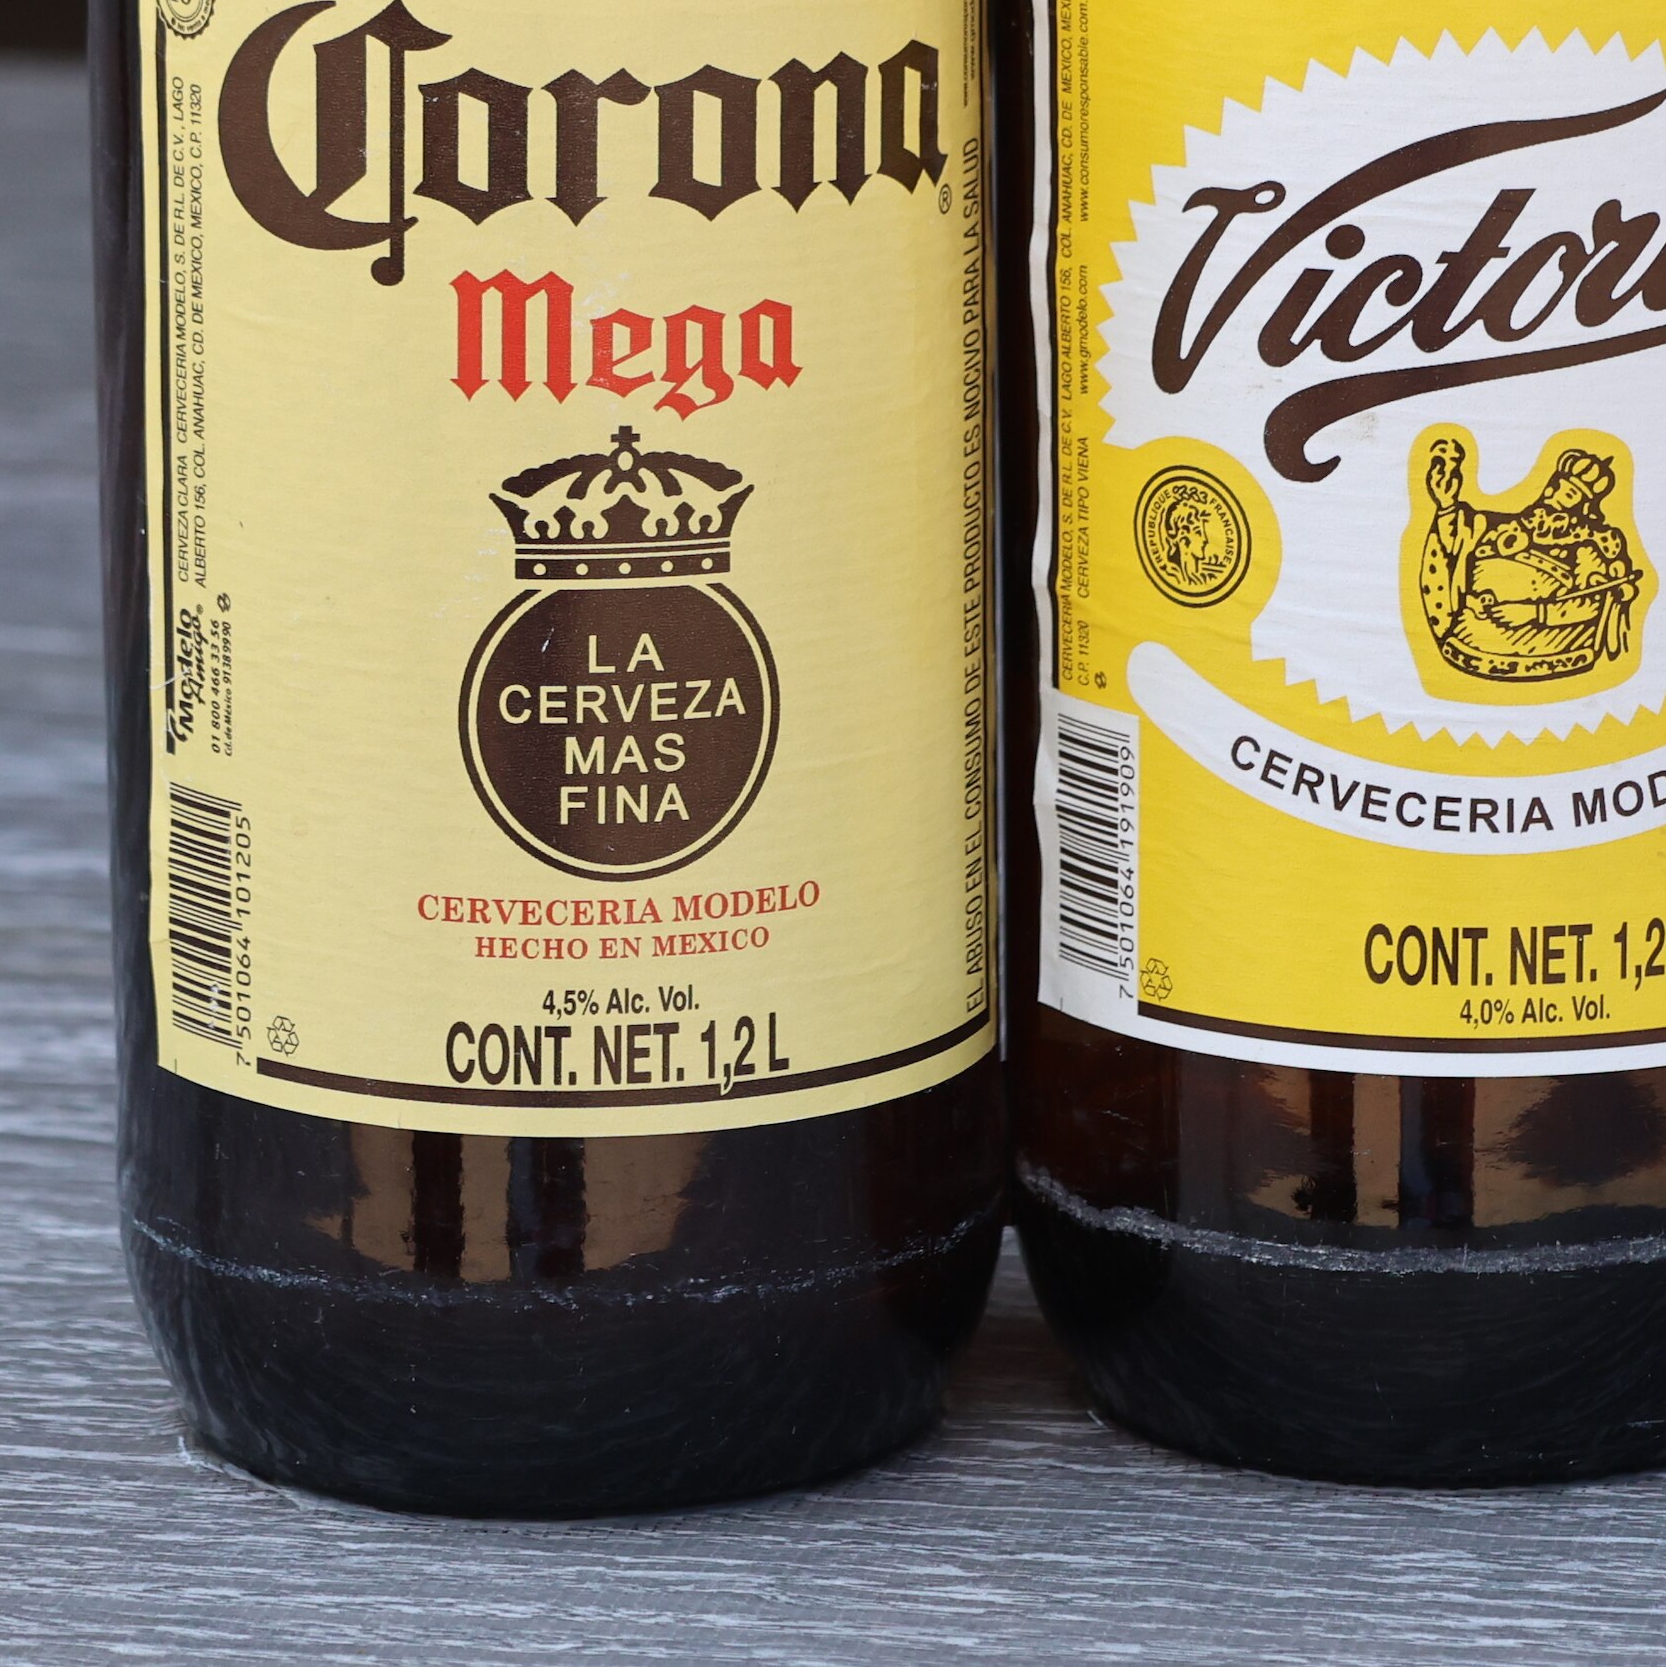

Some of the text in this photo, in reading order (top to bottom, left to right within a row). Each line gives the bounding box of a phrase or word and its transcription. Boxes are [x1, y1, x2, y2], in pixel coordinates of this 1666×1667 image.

[1060, 36, 1073, 94] MEXICO,
[172, 77, 184, 121] LAGO
[1061, 100, 1072, 121] DE
[1061, 125, 1072, 149] CD.
[174, 165, 185, 187] DE
[1061, 154, 1073, 224] ANAHUAC,
[174, 193, 185, 219] R.L.
[174, 224, 185, 245] DE
[174, 251, 185, 265] S.
[1060, 267, 1072, 292] 156,
[175, 269, 187, 341] MODELO,
[1060, 295, 1072, 360] ALBERTO
[189, 84, 206, 588] ALBERTO 156, COL. ANAHUAC, CD. DE MEXICO, MEXICO, C.P. 11320
[450, 268, 803, 421] Mega
[1076, 265, 1091, 395] www.gmodelo.com
[176, 343, 187, 443] CERVECERIA
[1060, 361, 1072, 401] LAGO
[1061, 408, 1073, 434] C.V.
[1061, 437, 1073, 457] DE
[1077, 437, 1090, 483] VIENA
[177, 455, 188, 507] CLARA
[1061, 461, 1073, 485] R.L.
[1061, 489, 1073, 508] DE
[1061, 513, 1073, 524] S.
[1077, 484, 1090, 523] TIPO
[178, 510, 189, 583] CERVEZA
[1061, 529, 1073, 591] MODELO,
[1077, 526, 1090, 599] CERVEZA
[963, 138, 983, 1013] EL ABUSO EN EL CONSUMO DE ESTE PRODUCTO ES NOCIVO PARA LA SALUD
[188, 614, 209, 705] Amigo
[589, 633, 664, 673] LA
[1061, 594, 1073, 681] CERVECERIA
[1077, 621, 1090, 657] 11320
[176, 608, 193, 734] Modelo
[211, 619, 220, 753] 01 800 466 33 56
[1077, 662, 1090, 686] C.P.
[499, 677, 746, 724] CERVEZA
[565, 733, 686, 774] MAS
[560, 783, 689, 825] FINA
[1230, 735, 1554, 834] CERVECERIA
[1120, 746, 1134, 999] 7 501064 191909
[417, 880, 820, 926] CERVECERIA MODELO
[236, 816, 251, 1067] 7 501064 101205
[475, 926, 769, 960] HECHO EN MEXICO
[1364, 923, 1493, 987] CONT.
[1510, 923, 1597, 986] NET.
[1614, 917, 1666, 991] 1,2
[542, 984, 700, 1020] 4,5% Alc. Vol.
[1460, 994, 1611, 1030] 4,0% Alc. Vol.
[446, 1012, 790, 1091] CONT. NET. 1,2 L
